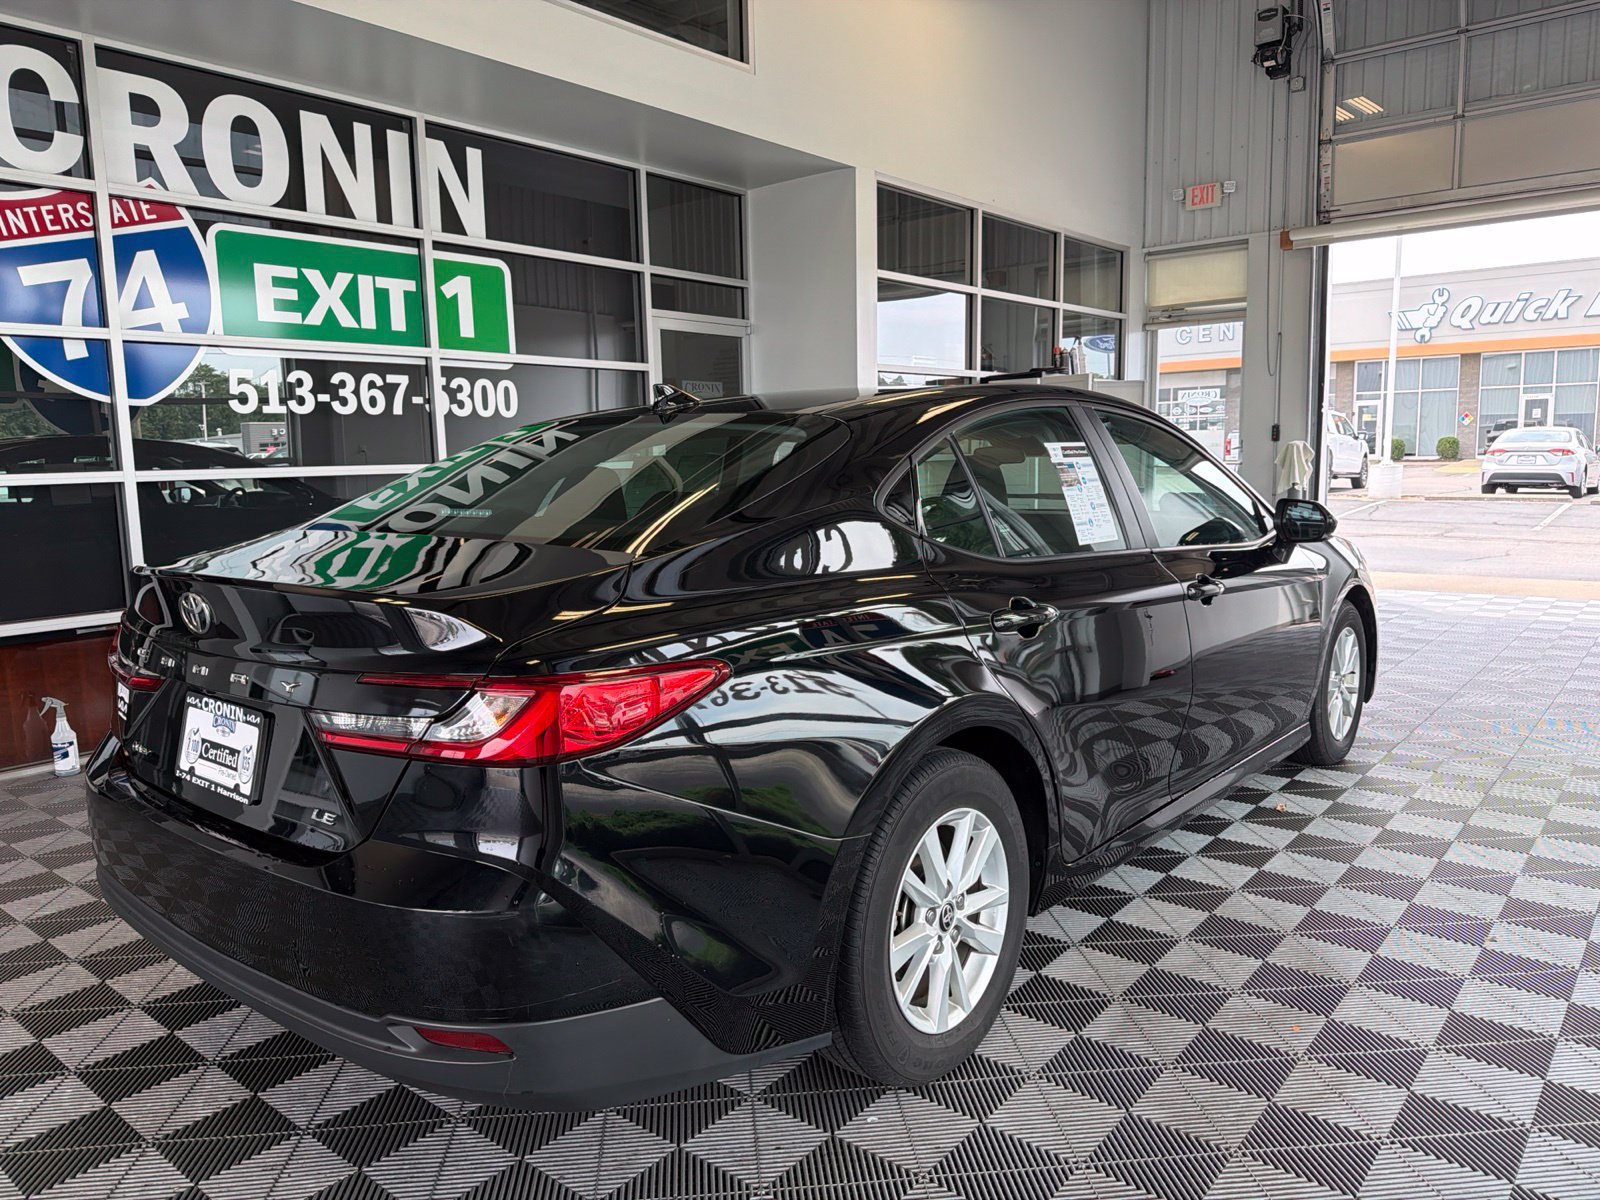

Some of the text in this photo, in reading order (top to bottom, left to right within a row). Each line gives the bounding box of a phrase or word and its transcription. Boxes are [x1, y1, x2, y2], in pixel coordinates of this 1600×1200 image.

[0, 44, 487, 239] CRONIN
[1191, 184, 1216, 206] EXIT
[0, 199, 157, 237] INTERSATE
[16, 249, 190, 361] 74
[253, 262, 475, 338] EXIT 1
[1450, 288, 1583, 331] Quick
[684, 382, 720, 393] CRONIN
[202, 697, 243, 722] CRONIN
[201, 742, 238, 768] Certified
[192, 776, 210, 788] EXIT
[217, 787, 249, 805] Harrison
[311, 808, 337, 826] LE
